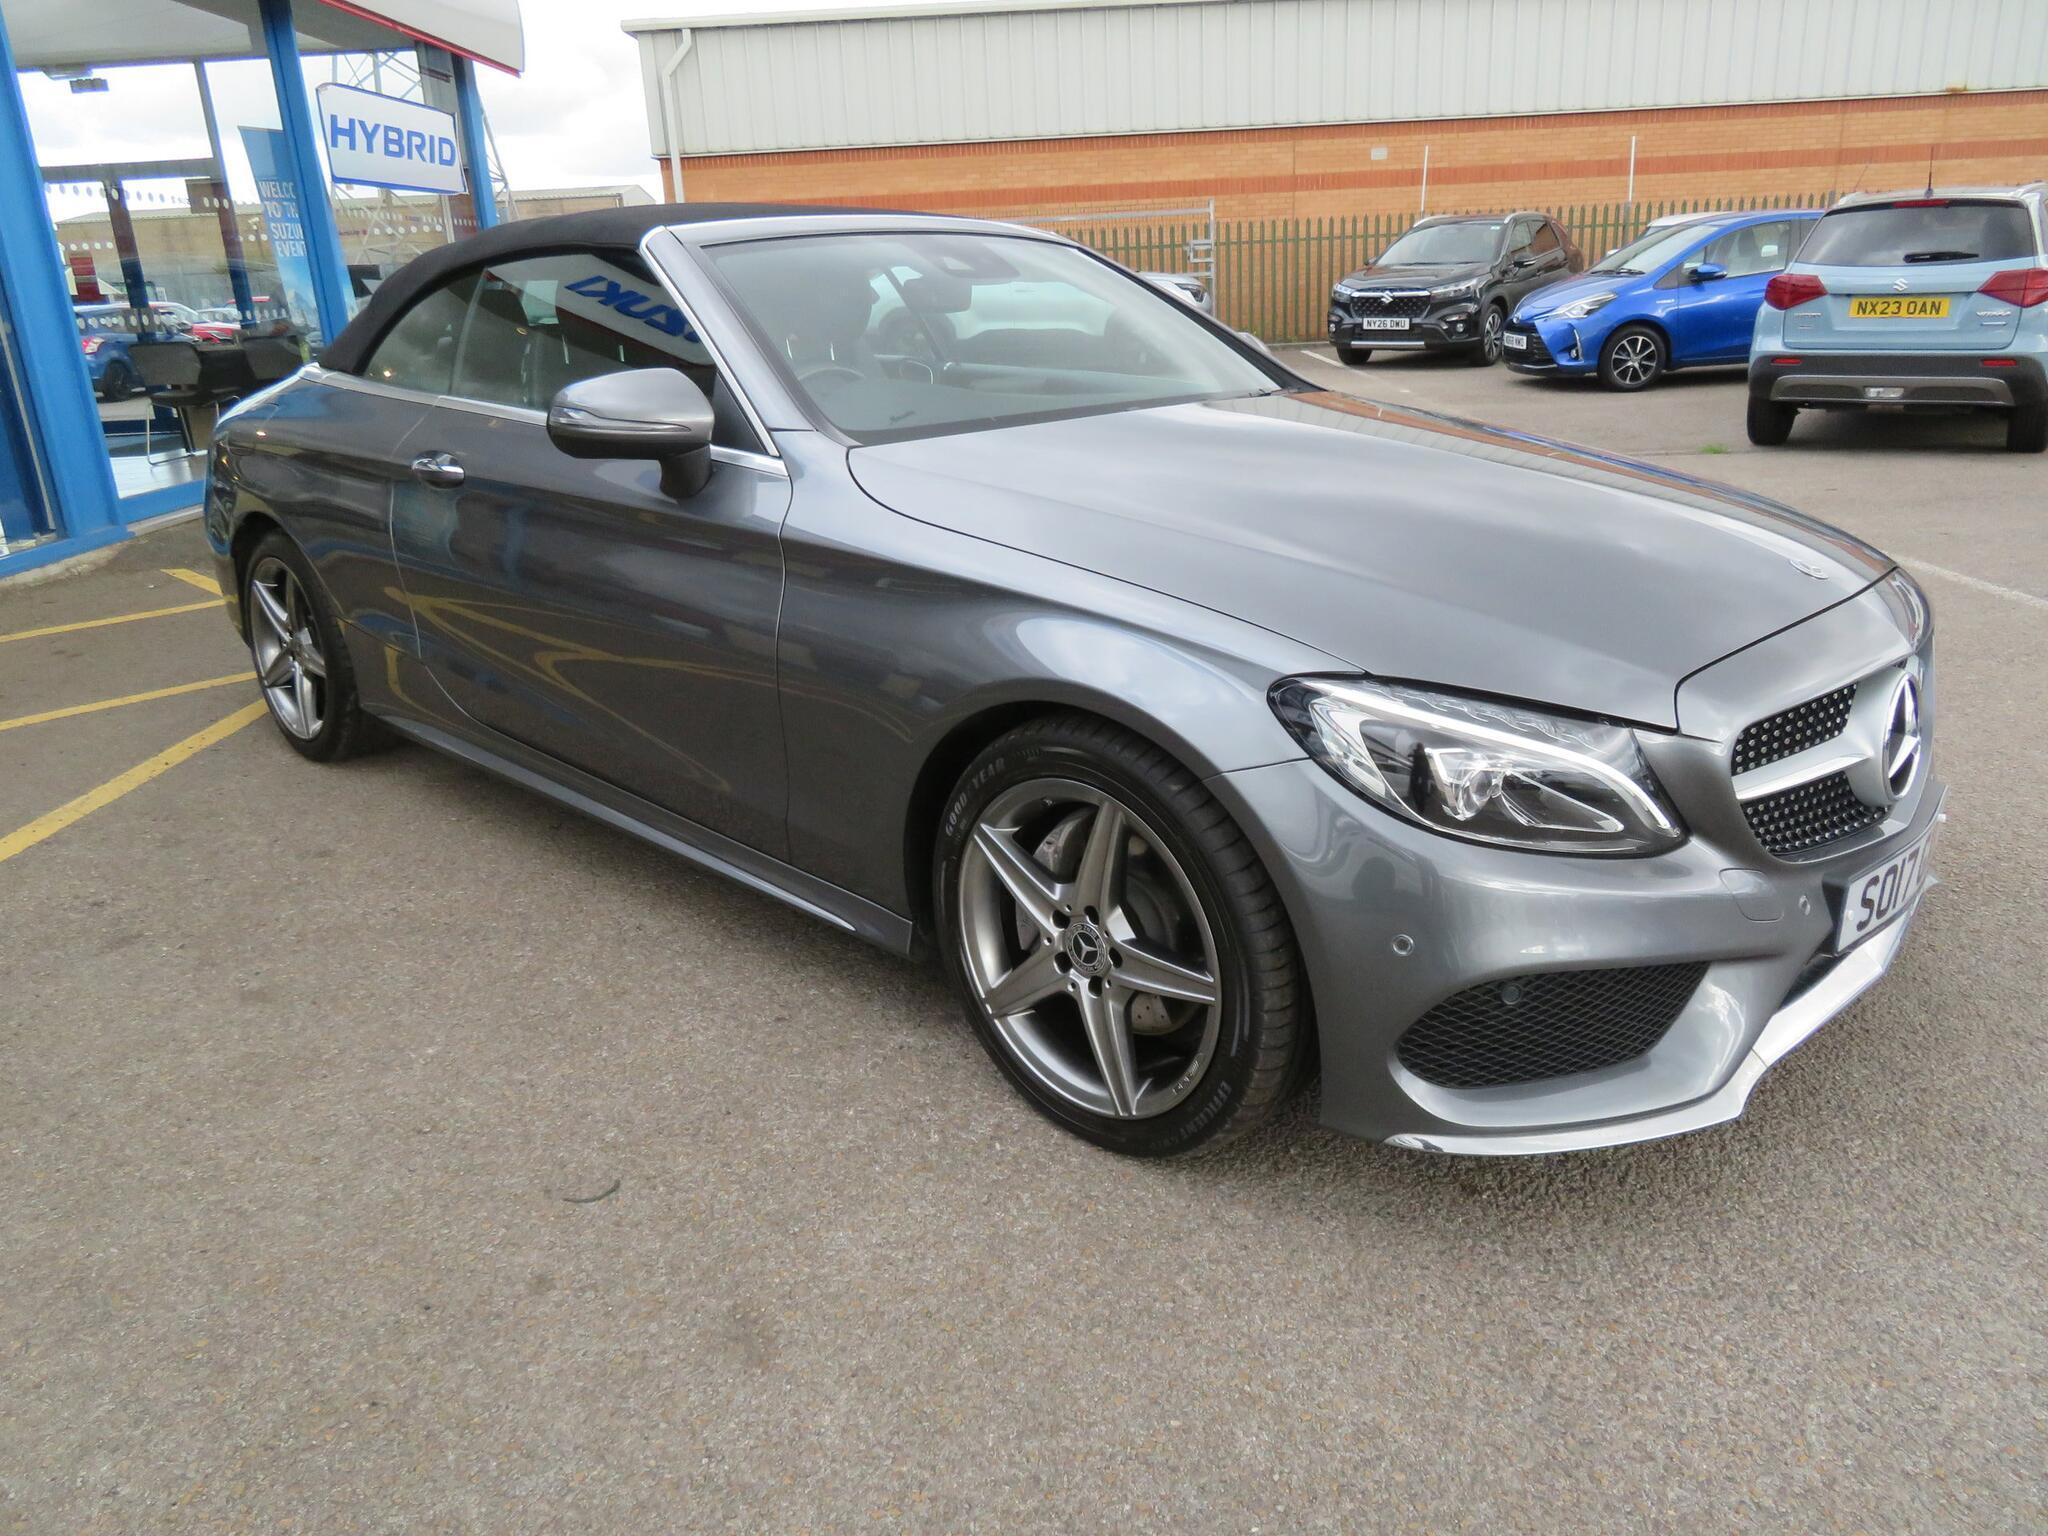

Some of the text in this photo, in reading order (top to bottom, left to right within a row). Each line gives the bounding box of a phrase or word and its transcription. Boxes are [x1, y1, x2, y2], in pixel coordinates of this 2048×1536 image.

[330, 113, 457, 168] HYBRID
[264, 201, 281, 218] TO
[1856, 301, 1942, 316] NX23 OAN
